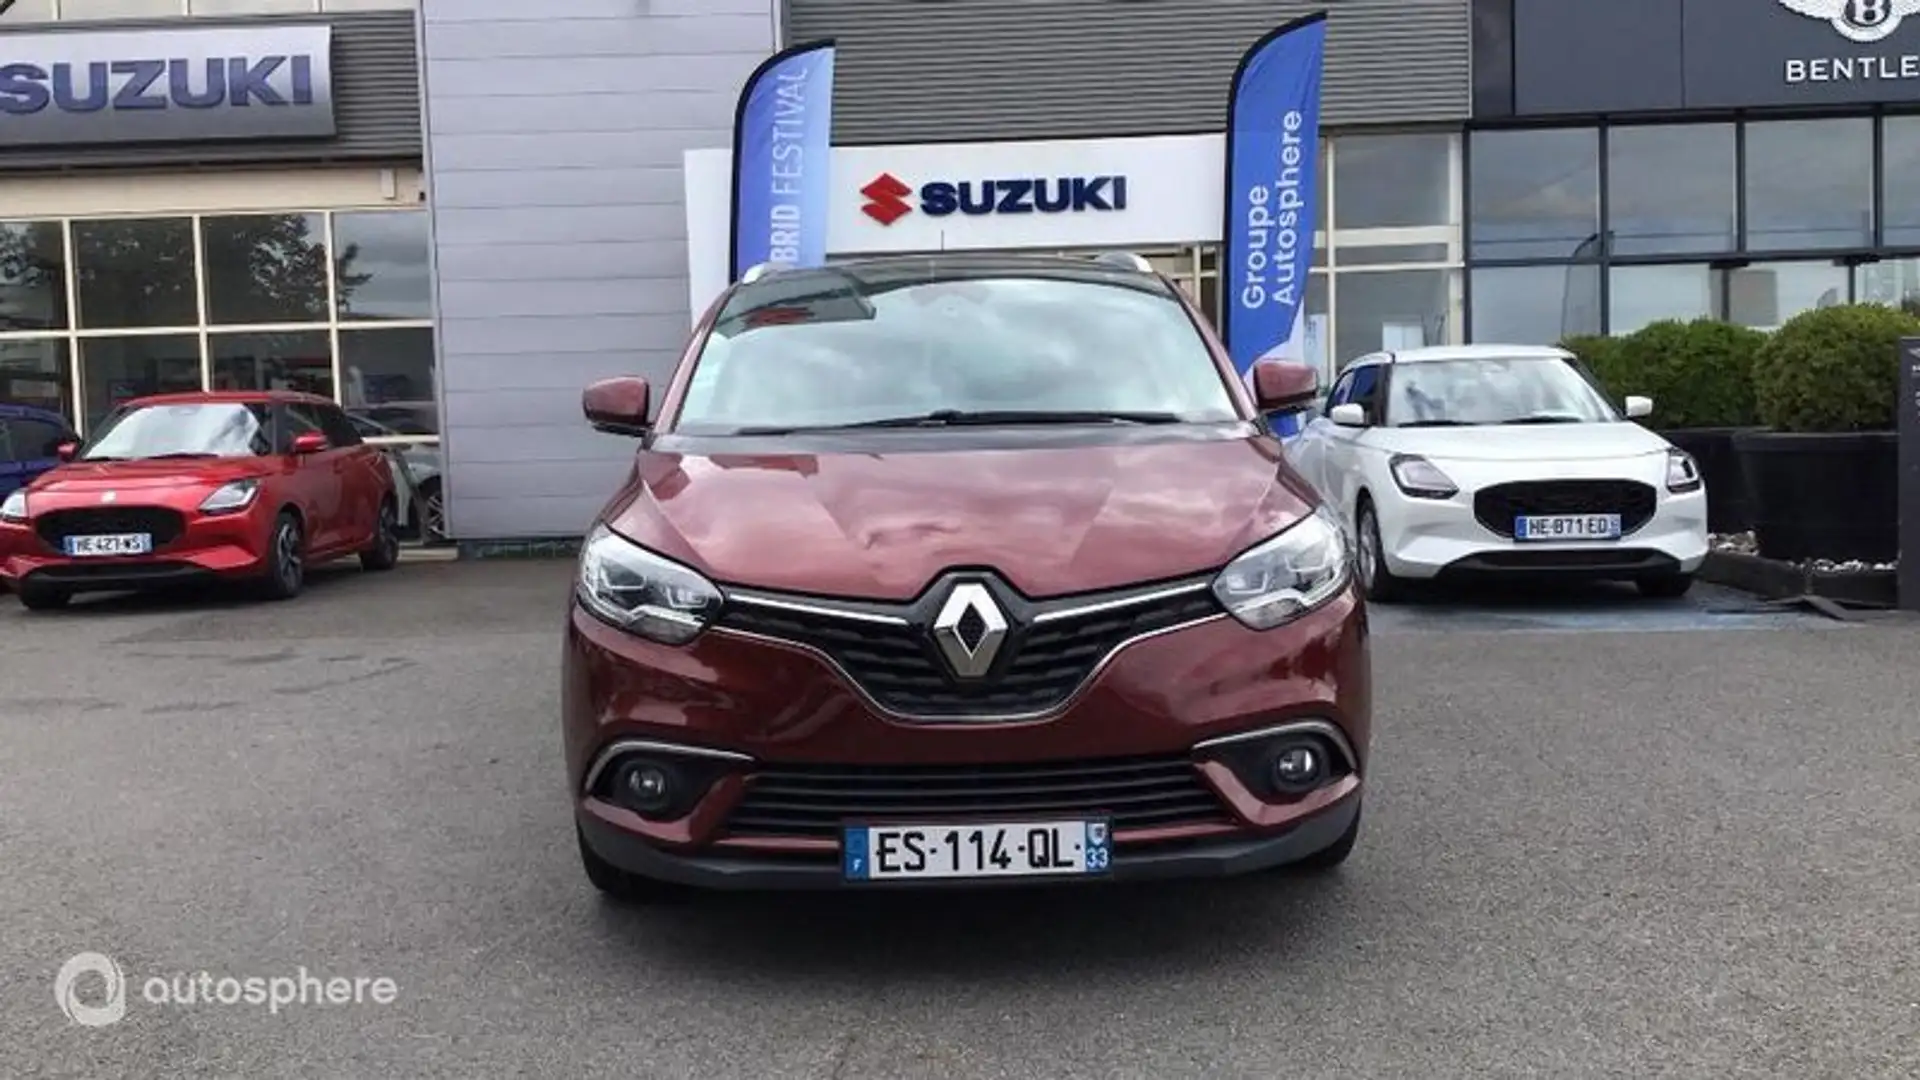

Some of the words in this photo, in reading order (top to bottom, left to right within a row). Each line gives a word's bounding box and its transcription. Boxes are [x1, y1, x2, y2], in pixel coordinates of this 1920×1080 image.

[0, 55, 313, 115] SUZUKI
[771, 67, 808, 195] FESTIVAL
[920, 176, 1126, 217] SUZUKI
[1273, 110, 1304, 305] Autosphere
[1242, 184, 1275, 309] Groupe
[1087, 848, 1108, 868] 33
